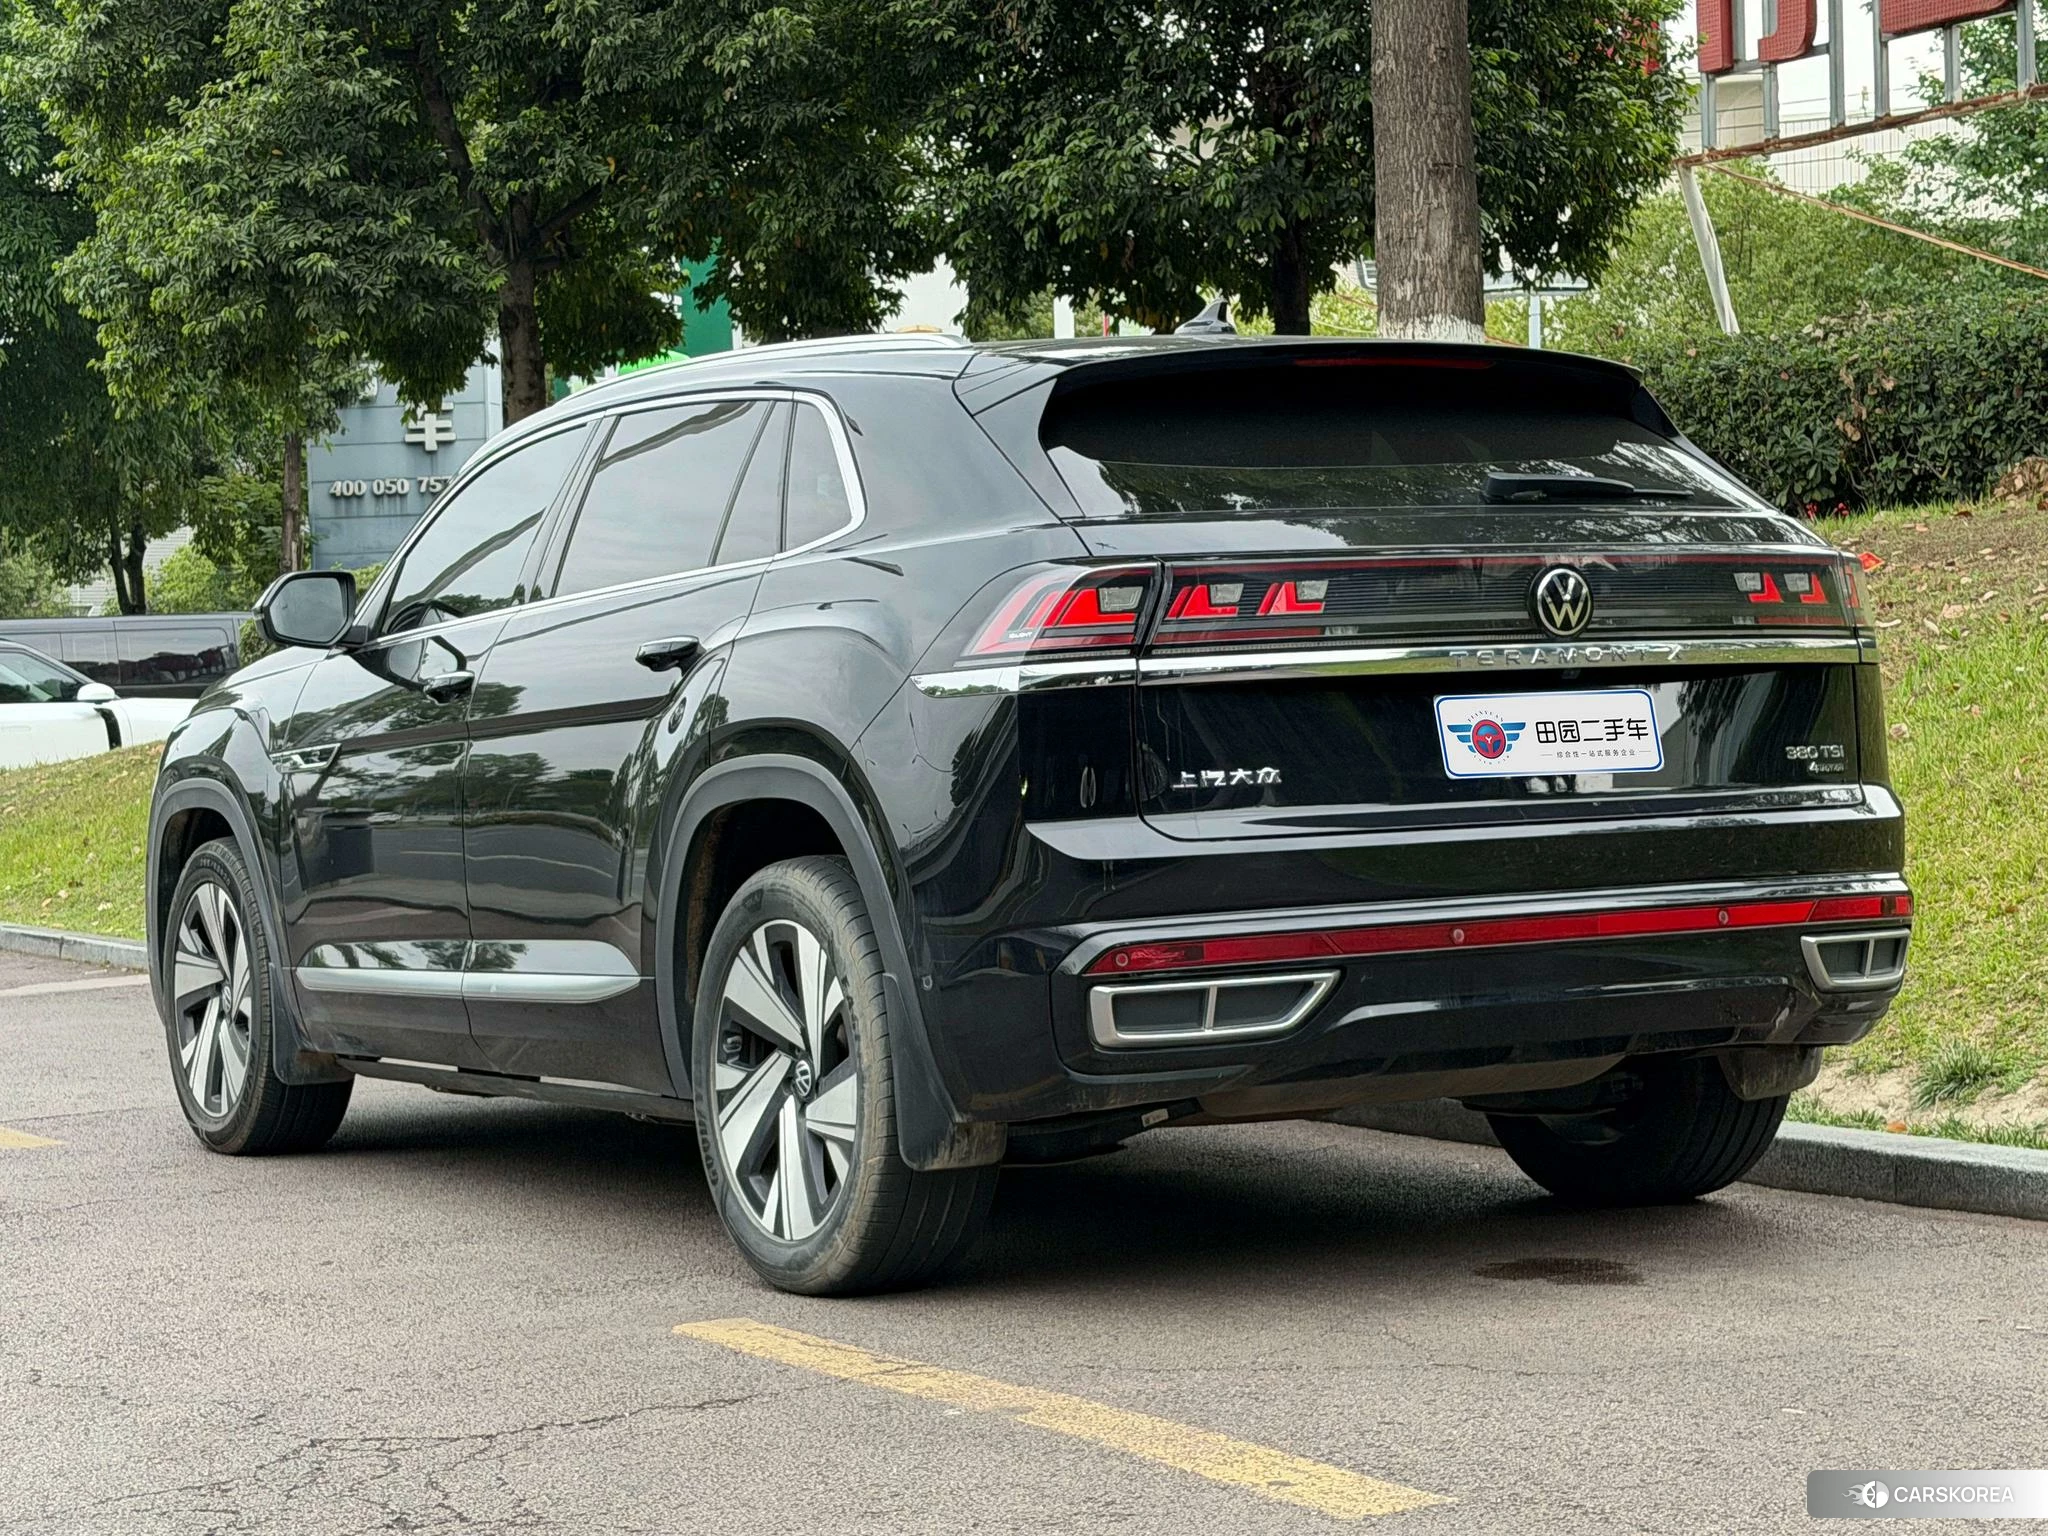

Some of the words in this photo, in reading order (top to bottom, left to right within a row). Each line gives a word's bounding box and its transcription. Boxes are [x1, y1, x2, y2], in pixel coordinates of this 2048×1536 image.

[328, 479, 367, 497] 400
[372, 477, 410, 496] 050
[1449, 645, 1652, 669] TERAMONT
[1535, 717, 1649, 743] 田园二手车
[1785, 745, 1819, 759] 380
[1820, 744, 1845, 758] TSI
[1171, 766, 1282, 788] 上汽大众
